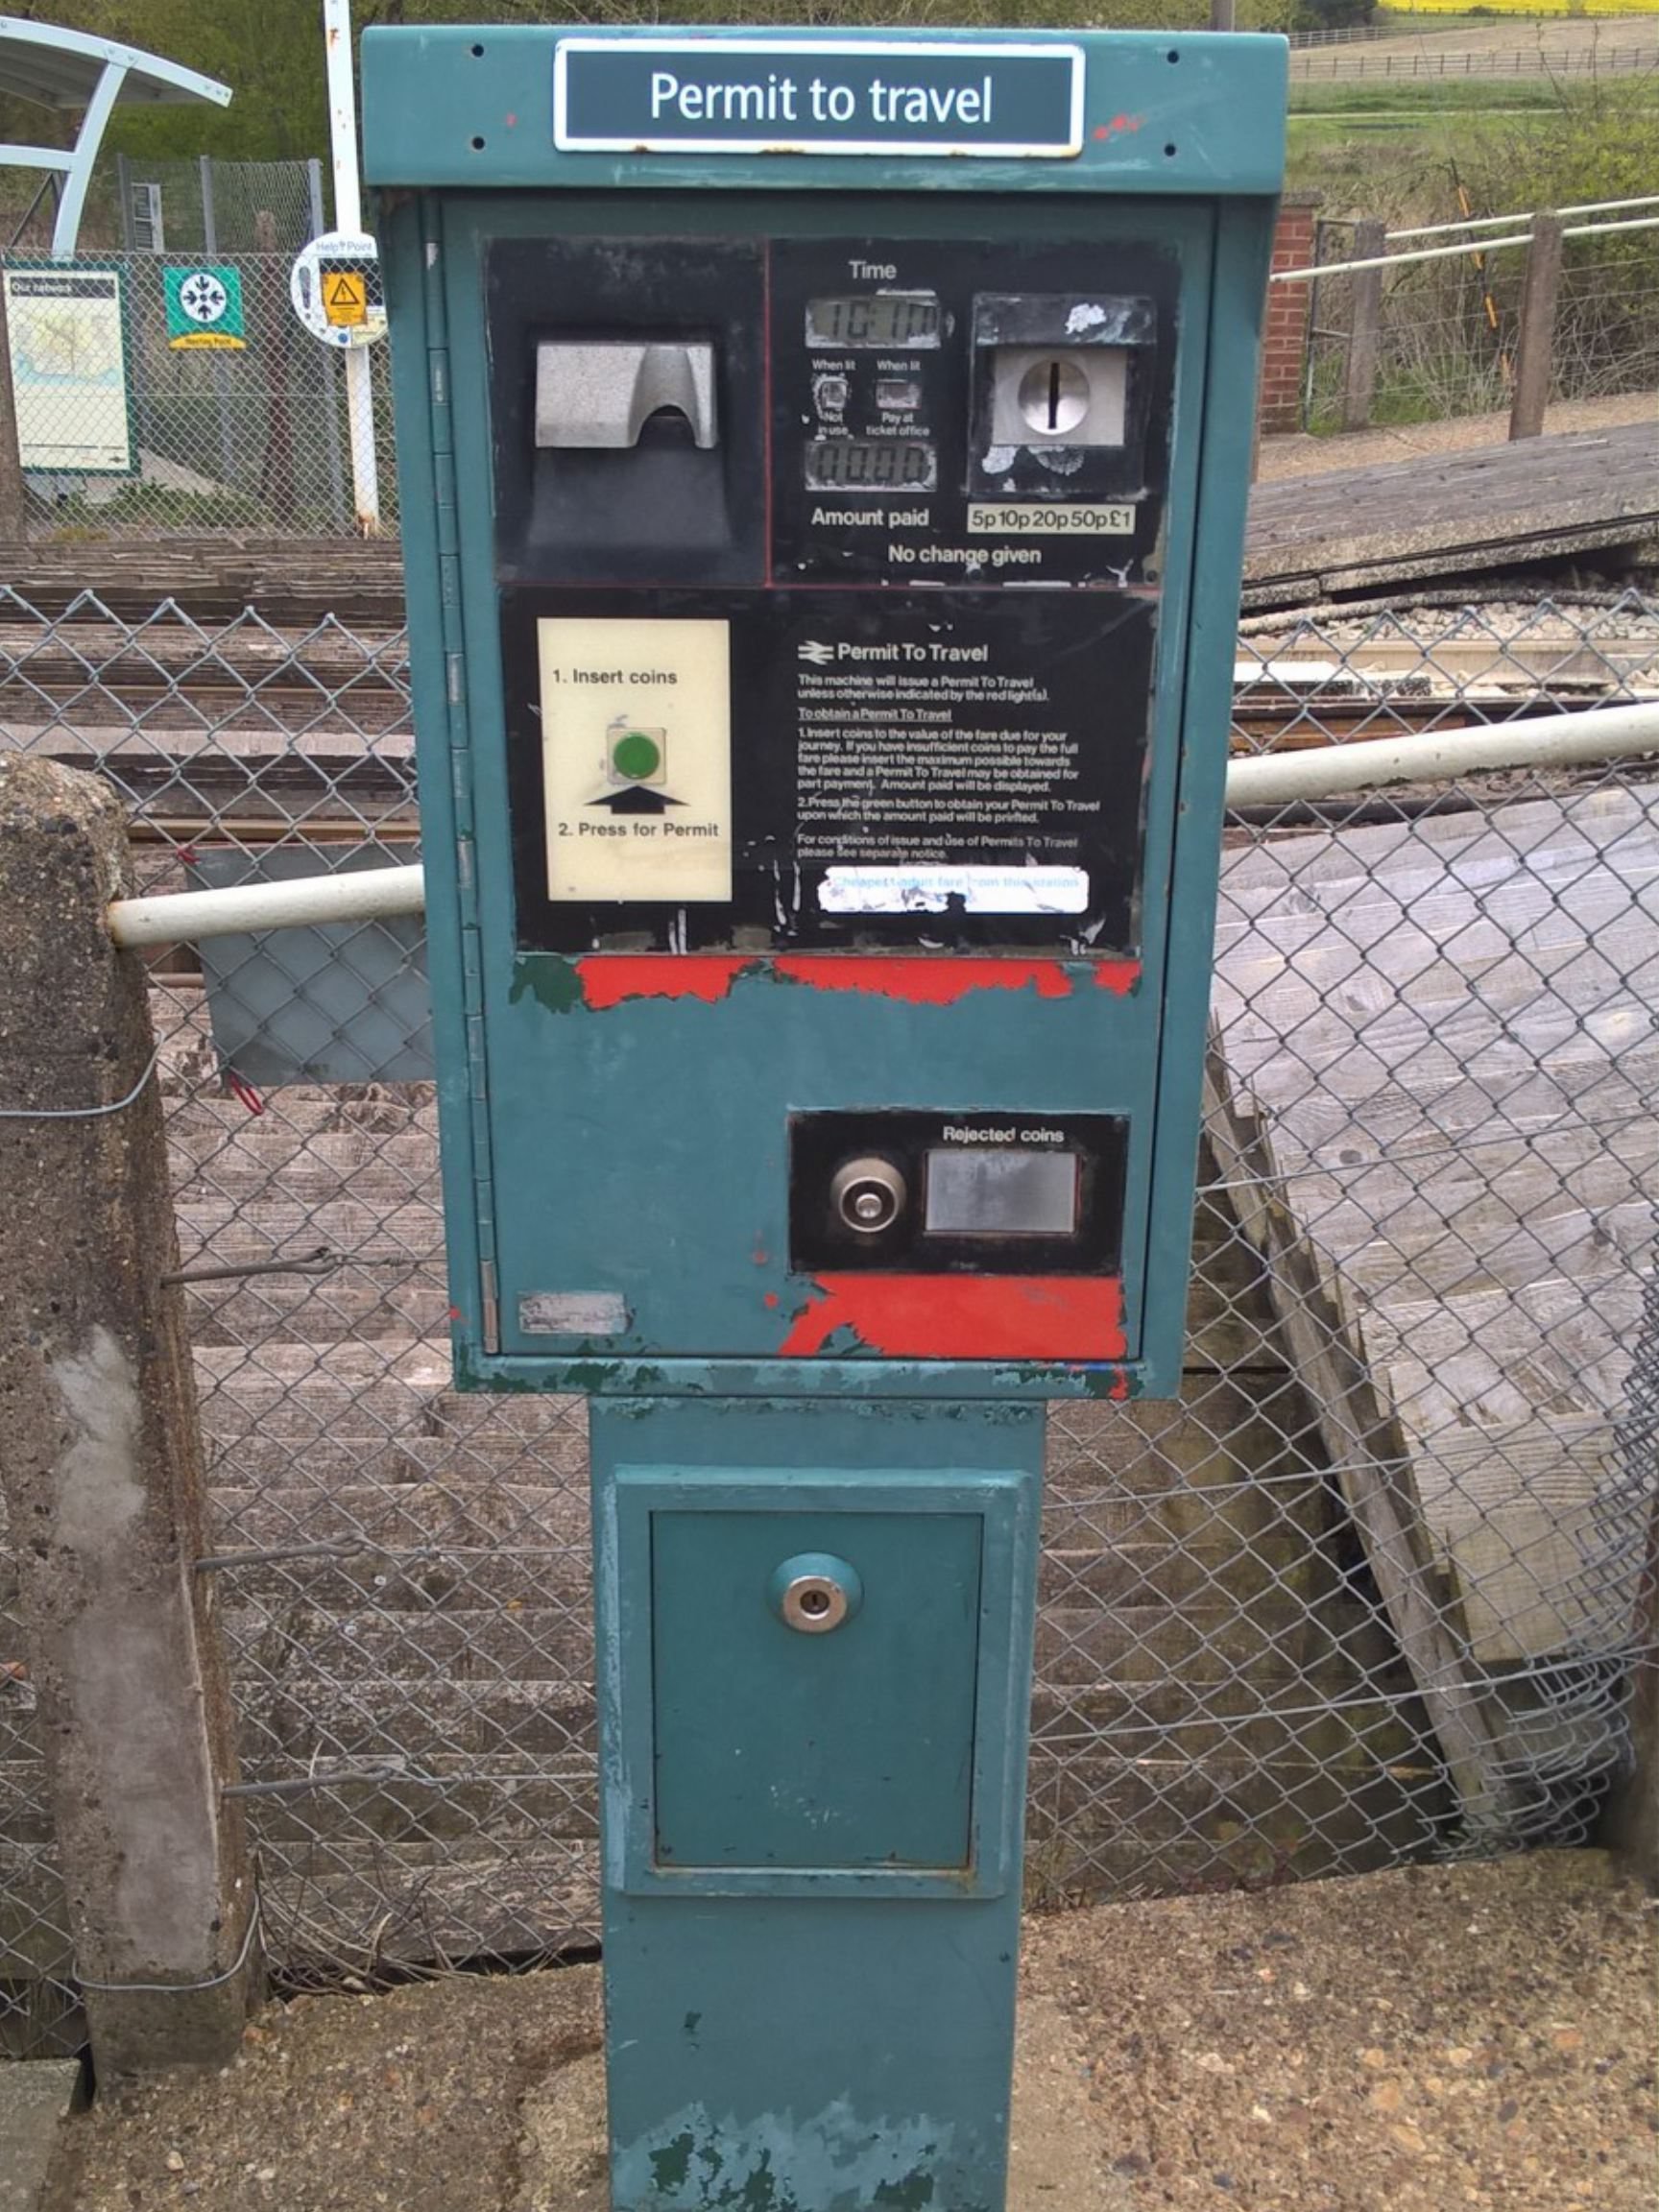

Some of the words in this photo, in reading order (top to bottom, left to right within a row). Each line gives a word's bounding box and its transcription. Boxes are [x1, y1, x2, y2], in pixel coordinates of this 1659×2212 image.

[650, 72, 798, 121] Permit
[807, 78, 856, 121] to
[869, 76, 994, 123] travel
[848, 260, 898, 279] Time
[812, 359, 843, 371] When
[877, 360, 908, 371] When
[882, 412, 902, 424] Pay
[902, 412, 914, 423] at
[866, 425, 897, 436] ticket
[899, 425, 930, 437] office
[811, 508, 884, 526] Amount
[888, 508, 929, 528] paid
[972, 510, 996, 530] 5p
[998, 511, 1030, 530] 10p
[1033, 511, 1069, 530] 20p
[1070, 511, 1108, 531] 50p
[1109, 512, 1131, 528] £1
[888, 545, 915, 563] No
[919, 545, 989, 565] change
[992, 546, 1042, 565] given
[838, 642, 899, 661] Permit
[902, 642, 926, 661] To
[928, 644, 989, 661] Travel
[552, 670, 566, 684] 1.
[573, 668, 623, 684] Insert
[630, 669, 678, 685] coins
[798, 674, 823, 685] This
[825, 674, 873, 686] machine
[876, 675, 896, 686] will
[898, 676, 929, 687] issue
[930, 678, 939, 687] a
[941, 676, 979, 687] Permit
[981, 676, 996, 687] To
[997, 676, 1034, 688] Travel
[798, 688, 834, 699] unless
[836, 688, 895, 700] otherwise
[896, 689, 948, 701] indicated
[950, 689, 964, 703] by
[966, 689, 984, 701] the
[986, 690, 1006, 701] red
[798, 707, 812, 721] To
[814, 708, 851, 721] obtain
[853, 710, 859, 721] a
[860, 709, 899, 722] Permit
[901, 709, 915, 722] To
[916, 709, 952, 723] Travel
[842, 728, 874, 739] coins
[876, 729, 887, 739] to
[888, 728, 907, 739] the
[908, 729, 939, 740] value
[941, 729, 953, 740] of
[954, 729, 974, 740] the
[975, 730, 998, 740] fare
[999, 730, 1022, 741] due
[1022, 731, 1039, 741] for
[1042, 732, 1067, 743] your
[855, 742, 877, 753] you
[878, 741, 905, 752] have
[906, 741, 969, 753] insufficient
[970, 742, 1001, 753] coins
[1003, 743, 1015, 753] to
[1017, 744, 1038, 756] pay
[1039, 743, 1058, 754] the
[1060, 743, 1078, 754] full
[798, 753, 822, 763] fare
[822, 754, 860, 765] please
[862, 754, 895, 764] insert
[896, 754, 915, 764] the
[917, 755, 973, 765] maximum
[974, 756, 1022, 767] possible
[1024, 756, 1070, 767] towards
[798, 765, 817, 776] the
[818, 765, 842, 777] fare
[843, 766, 865, 777] and
[866, 768, 874, 777] a
[875, 766, 913, 777] Permit
[914, 766, 929, 778] To
[930, 767, 967, 778] Travel
[967, 769, 992, 781] may
[993, 768, 1008, 780] be
[1010, 768, 1061, 781] obtained
[1063, 769, 1079, 780] for
[797, 779, 821, 790] part
[881, 779, 926, 790] Amount
[928, 780, 953, 792] paid
[955, 781, 975, 790] will
[976, 781, 992, 791] be
[842, 797, 859, 808] the
[862, 799, 895, 810] green
[896, 799, 933, 809] button
[934, 799, 946, 809] to
[947, 799, 983, 809] obtain
[985, 801, 1009, 812] your
[1011, 799, 1047, 810] Permit
[1050, 800, 1065, 811] To
[1066, 800, 1100, 811] Travel
[797, 810, 827, 822] upon
[828, 810, 861, 821] which
[863, 810, 881, 821] the
[883, 811, 926, 822] amount
[928, 812, 953, 824] paid
[956, 812, 975, 823] will
[977, 812, 992, 823] be
[558, 823, 573, 836] 2.
[579, 823, 627, 837] Press
[634, 823, 658, 837] for
[663, 823, 719, 837] Permit
[797, 834, 815, 845] For
[818, 834, 876, 846] conditions
[878, 835, 889, 845] of
[890, 835, 921, 846] issue
[922, 835, 943, 847] and
[946, 836, 964, 847] use
[967, 836, 979, 847] of
[981, 835, 1024, 847] Permits
[1026, 836, 1042, 848] To
[1043, 836, 1078, 849] Travel
[797, 848, 834, 859] please
[837, 849, 857, 858] see
[859, 849, 908, 861] separate
[943, 1125, 1016, 1142] Rejected
[1020, 1127, 1065, 1142] coins
